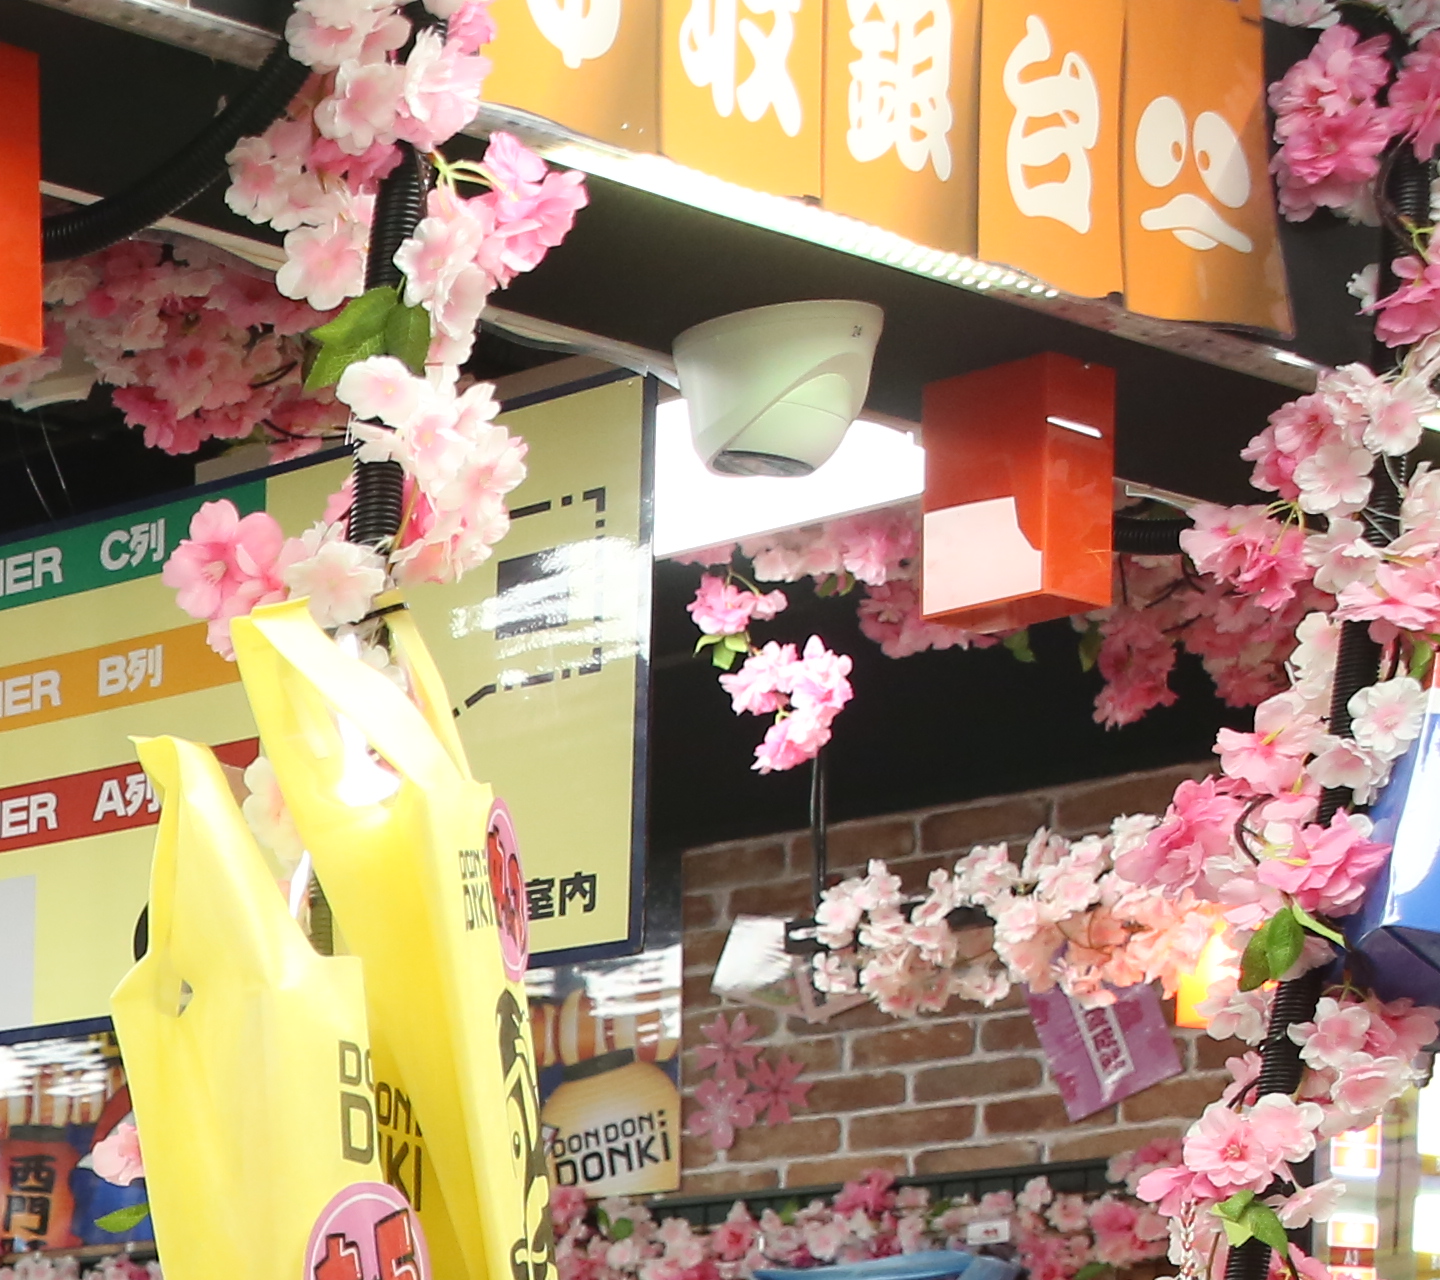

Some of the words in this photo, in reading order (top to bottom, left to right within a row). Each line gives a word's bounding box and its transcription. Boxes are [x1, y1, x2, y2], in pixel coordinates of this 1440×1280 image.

[100, 517, 167, 574] C列
[97, 645, 164, 699] B列
[92, 772, 161, 823] A列
[3, 1153, 56, 1252] 西門
